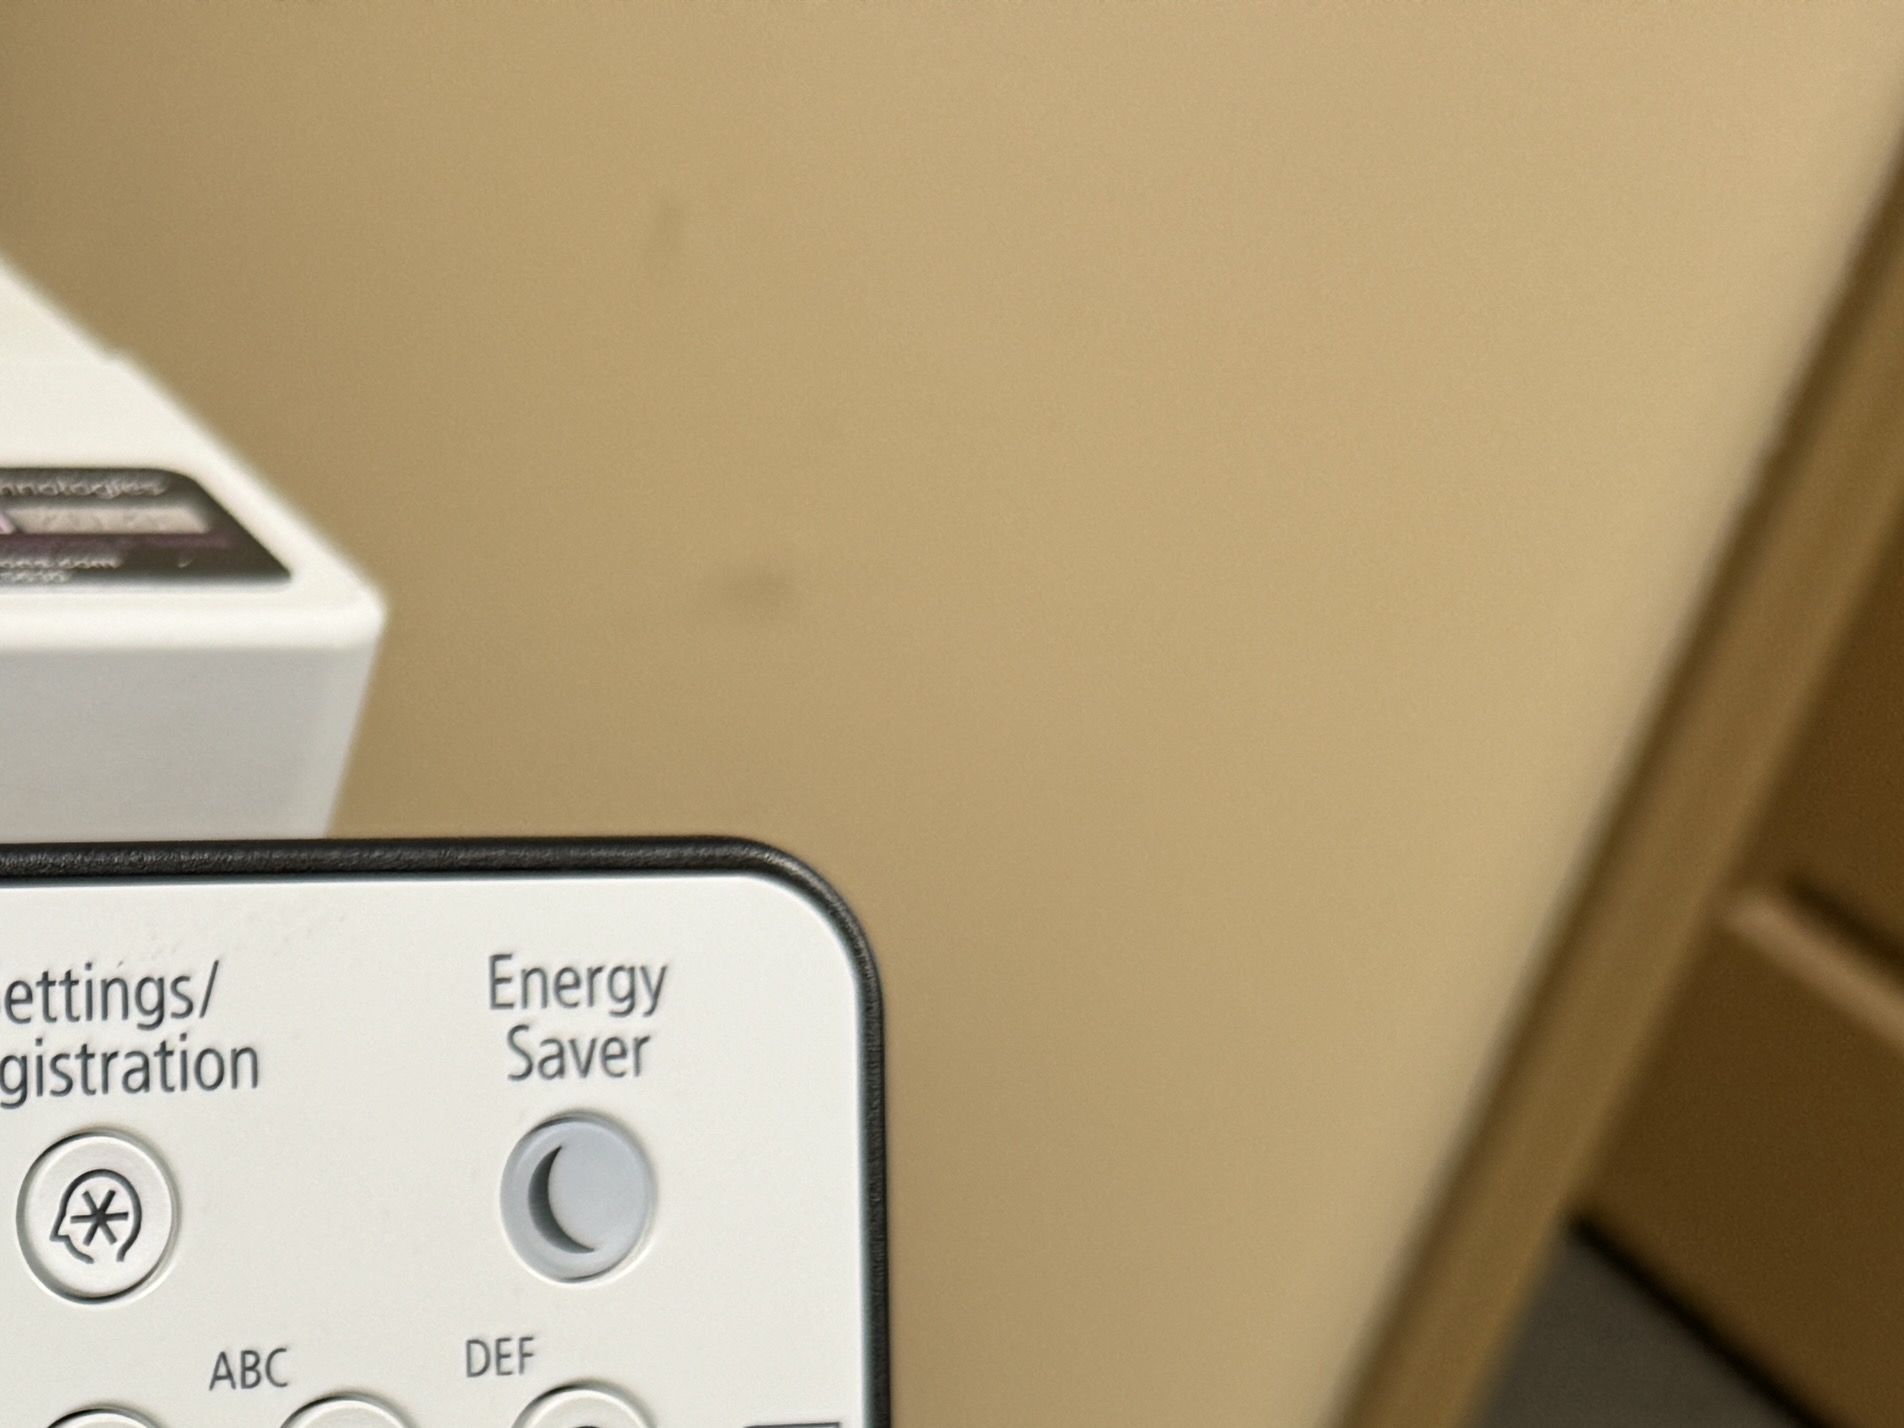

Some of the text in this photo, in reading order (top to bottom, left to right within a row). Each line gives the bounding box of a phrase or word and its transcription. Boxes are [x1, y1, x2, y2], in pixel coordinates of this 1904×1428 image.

[488, 953, 667, 1019] Energy
[507, 1025, 651, 1083] Saver
[208, 1347, 290, 1391] ABC
[464, 1336, 535, 1379] DEF
